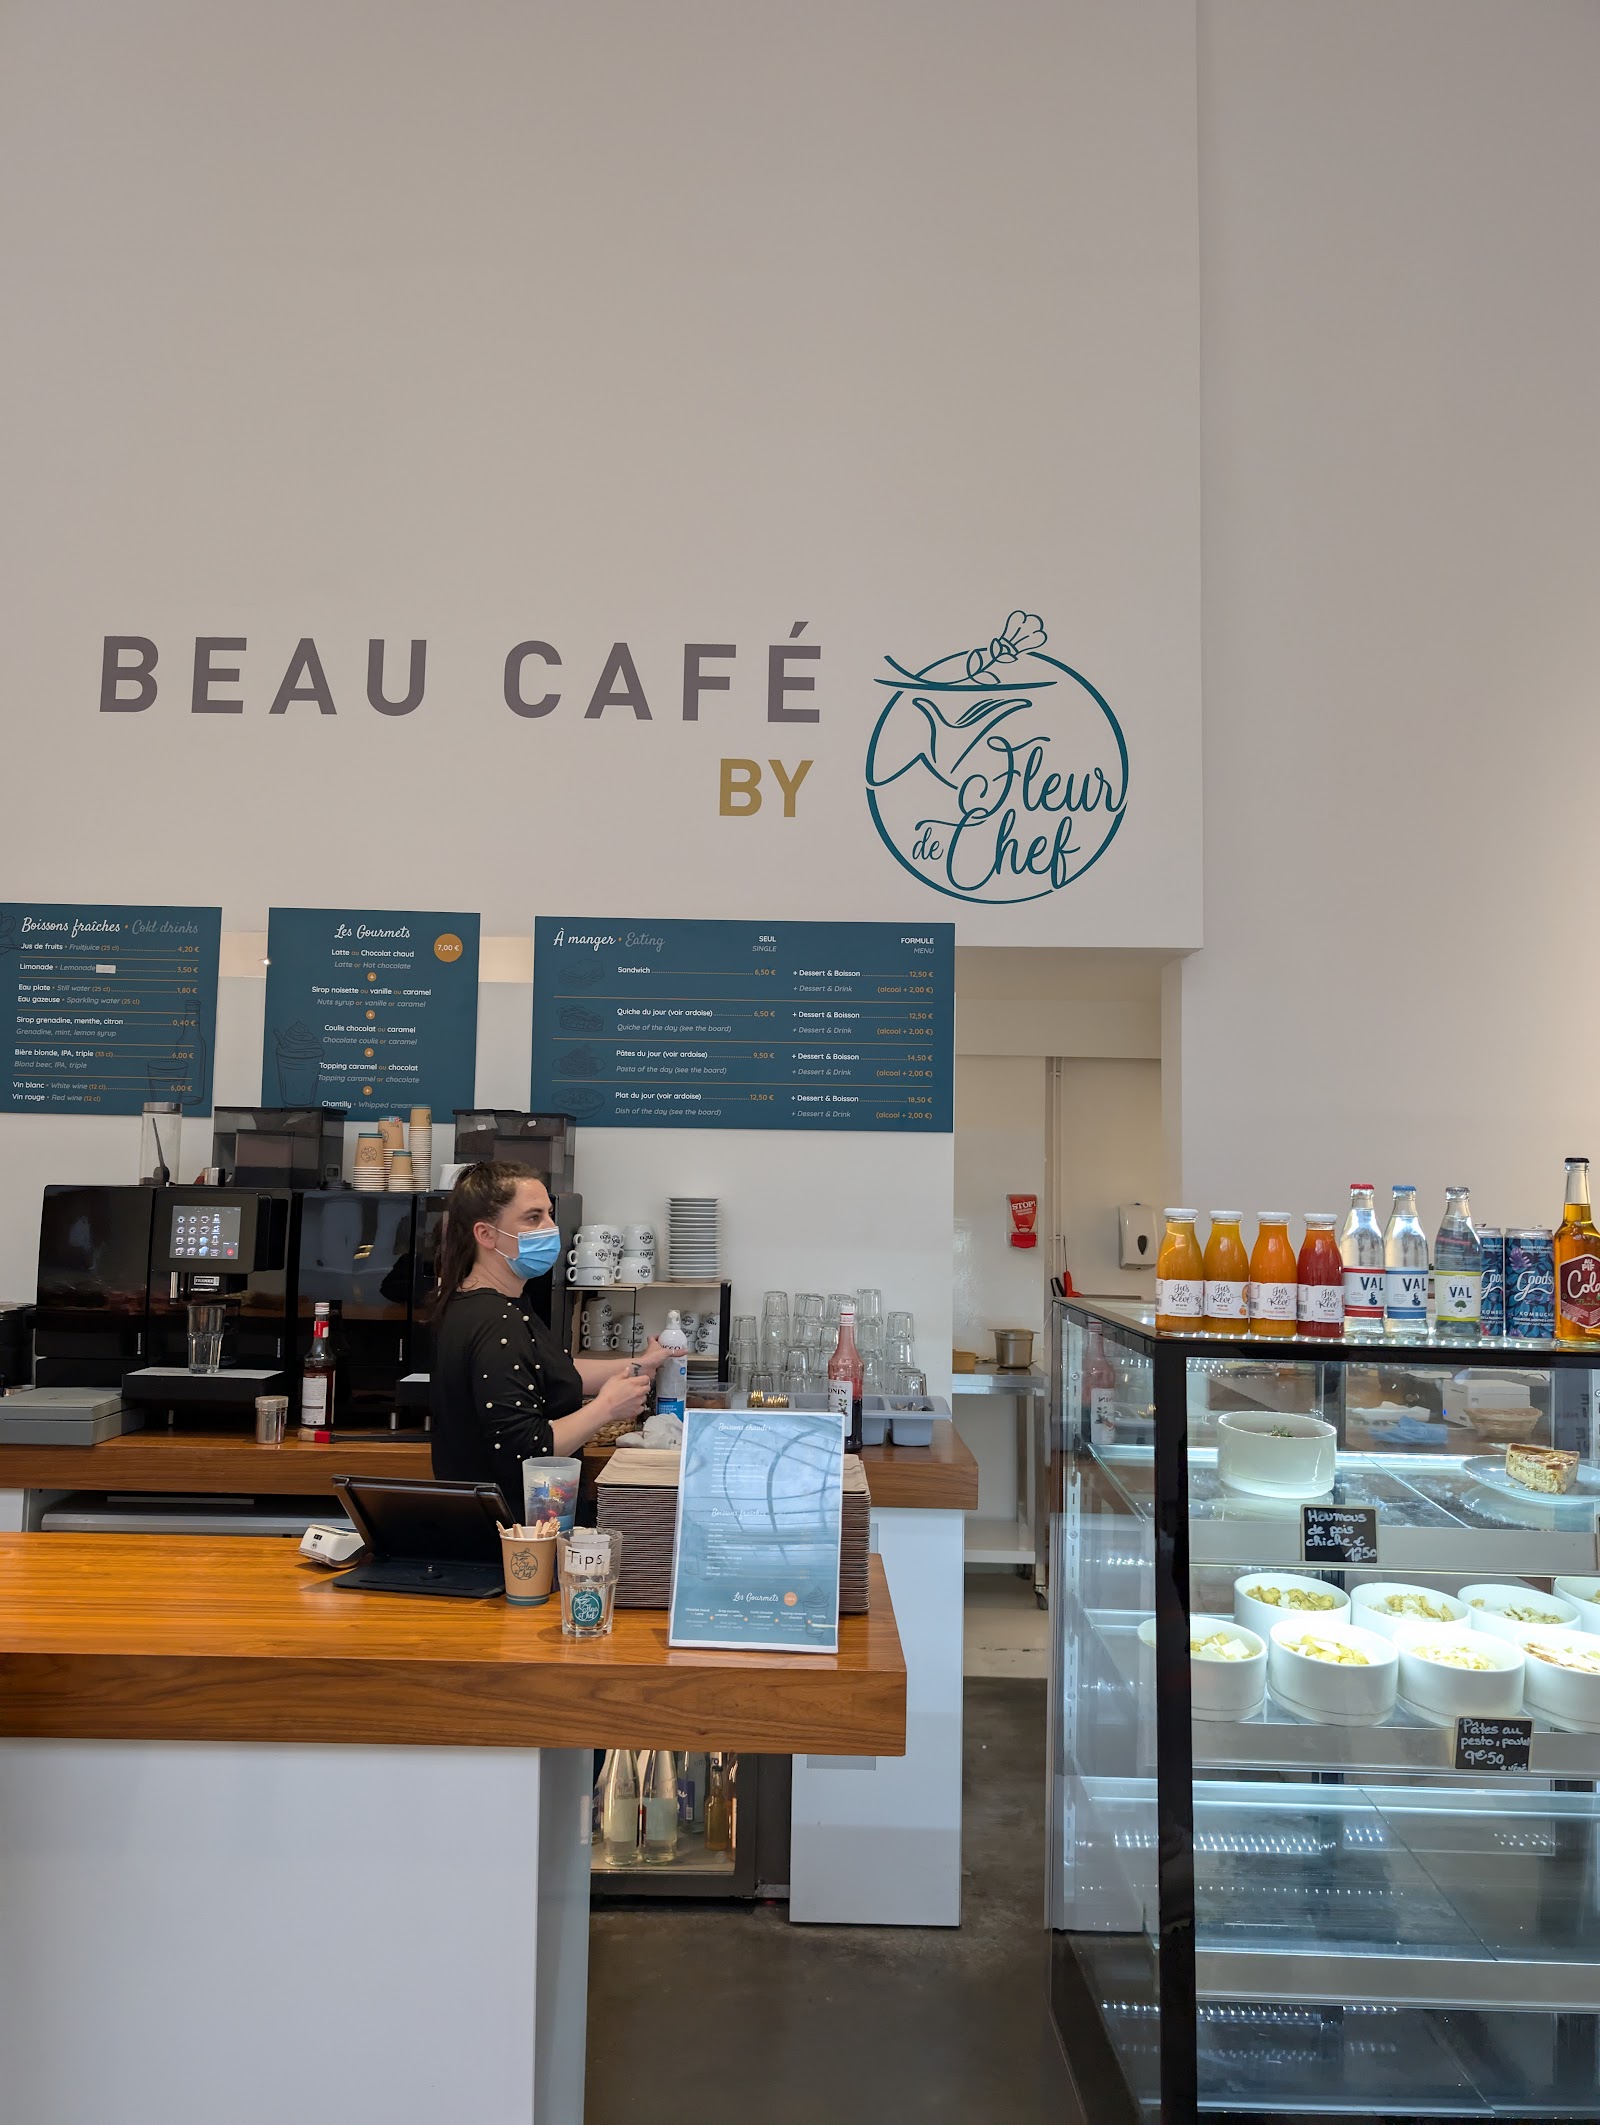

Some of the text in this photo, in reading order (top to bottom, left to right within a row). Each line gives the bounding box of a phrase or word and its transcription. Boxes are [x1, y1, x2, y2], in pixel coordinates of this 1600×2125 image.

[98, 621, 822, 723] BEAU CAFÉ
[957, 735, 1122, 820] Fleur
[718, 757, 815, 819] BY
[911, 807, 1081, 891] de Chef
[22, 917, 198, 938] Boissons fraîches Cold drinks
[334, 924, 410, 939] Les Gourmets
[553, 928, 665, 952] À manger Eating
[67, 997, 99, 1005] Sparkling
[617, 1008, 640, 1016] Quiche
[320, 1063, 347, 1071] Topping
[1012, 1200, 1036, 1210] STOP!
[1360, 1277, 1383, 1291] VAL
[1402, 1278, 1426, 1292] VAL
[1449, 1286, 1472, 1298] VAL
[1307, 1509, 1367, 1522] Houmous
[1307, 1523, 1354, 1537] de pois
[567, 1549, 603, 1570] Tips
[732, 1592, 744, 1602] Les
[746, 1592, 779, 1602] Gourmets
[1463, 1718, 1523, 1735] Pâtes au
